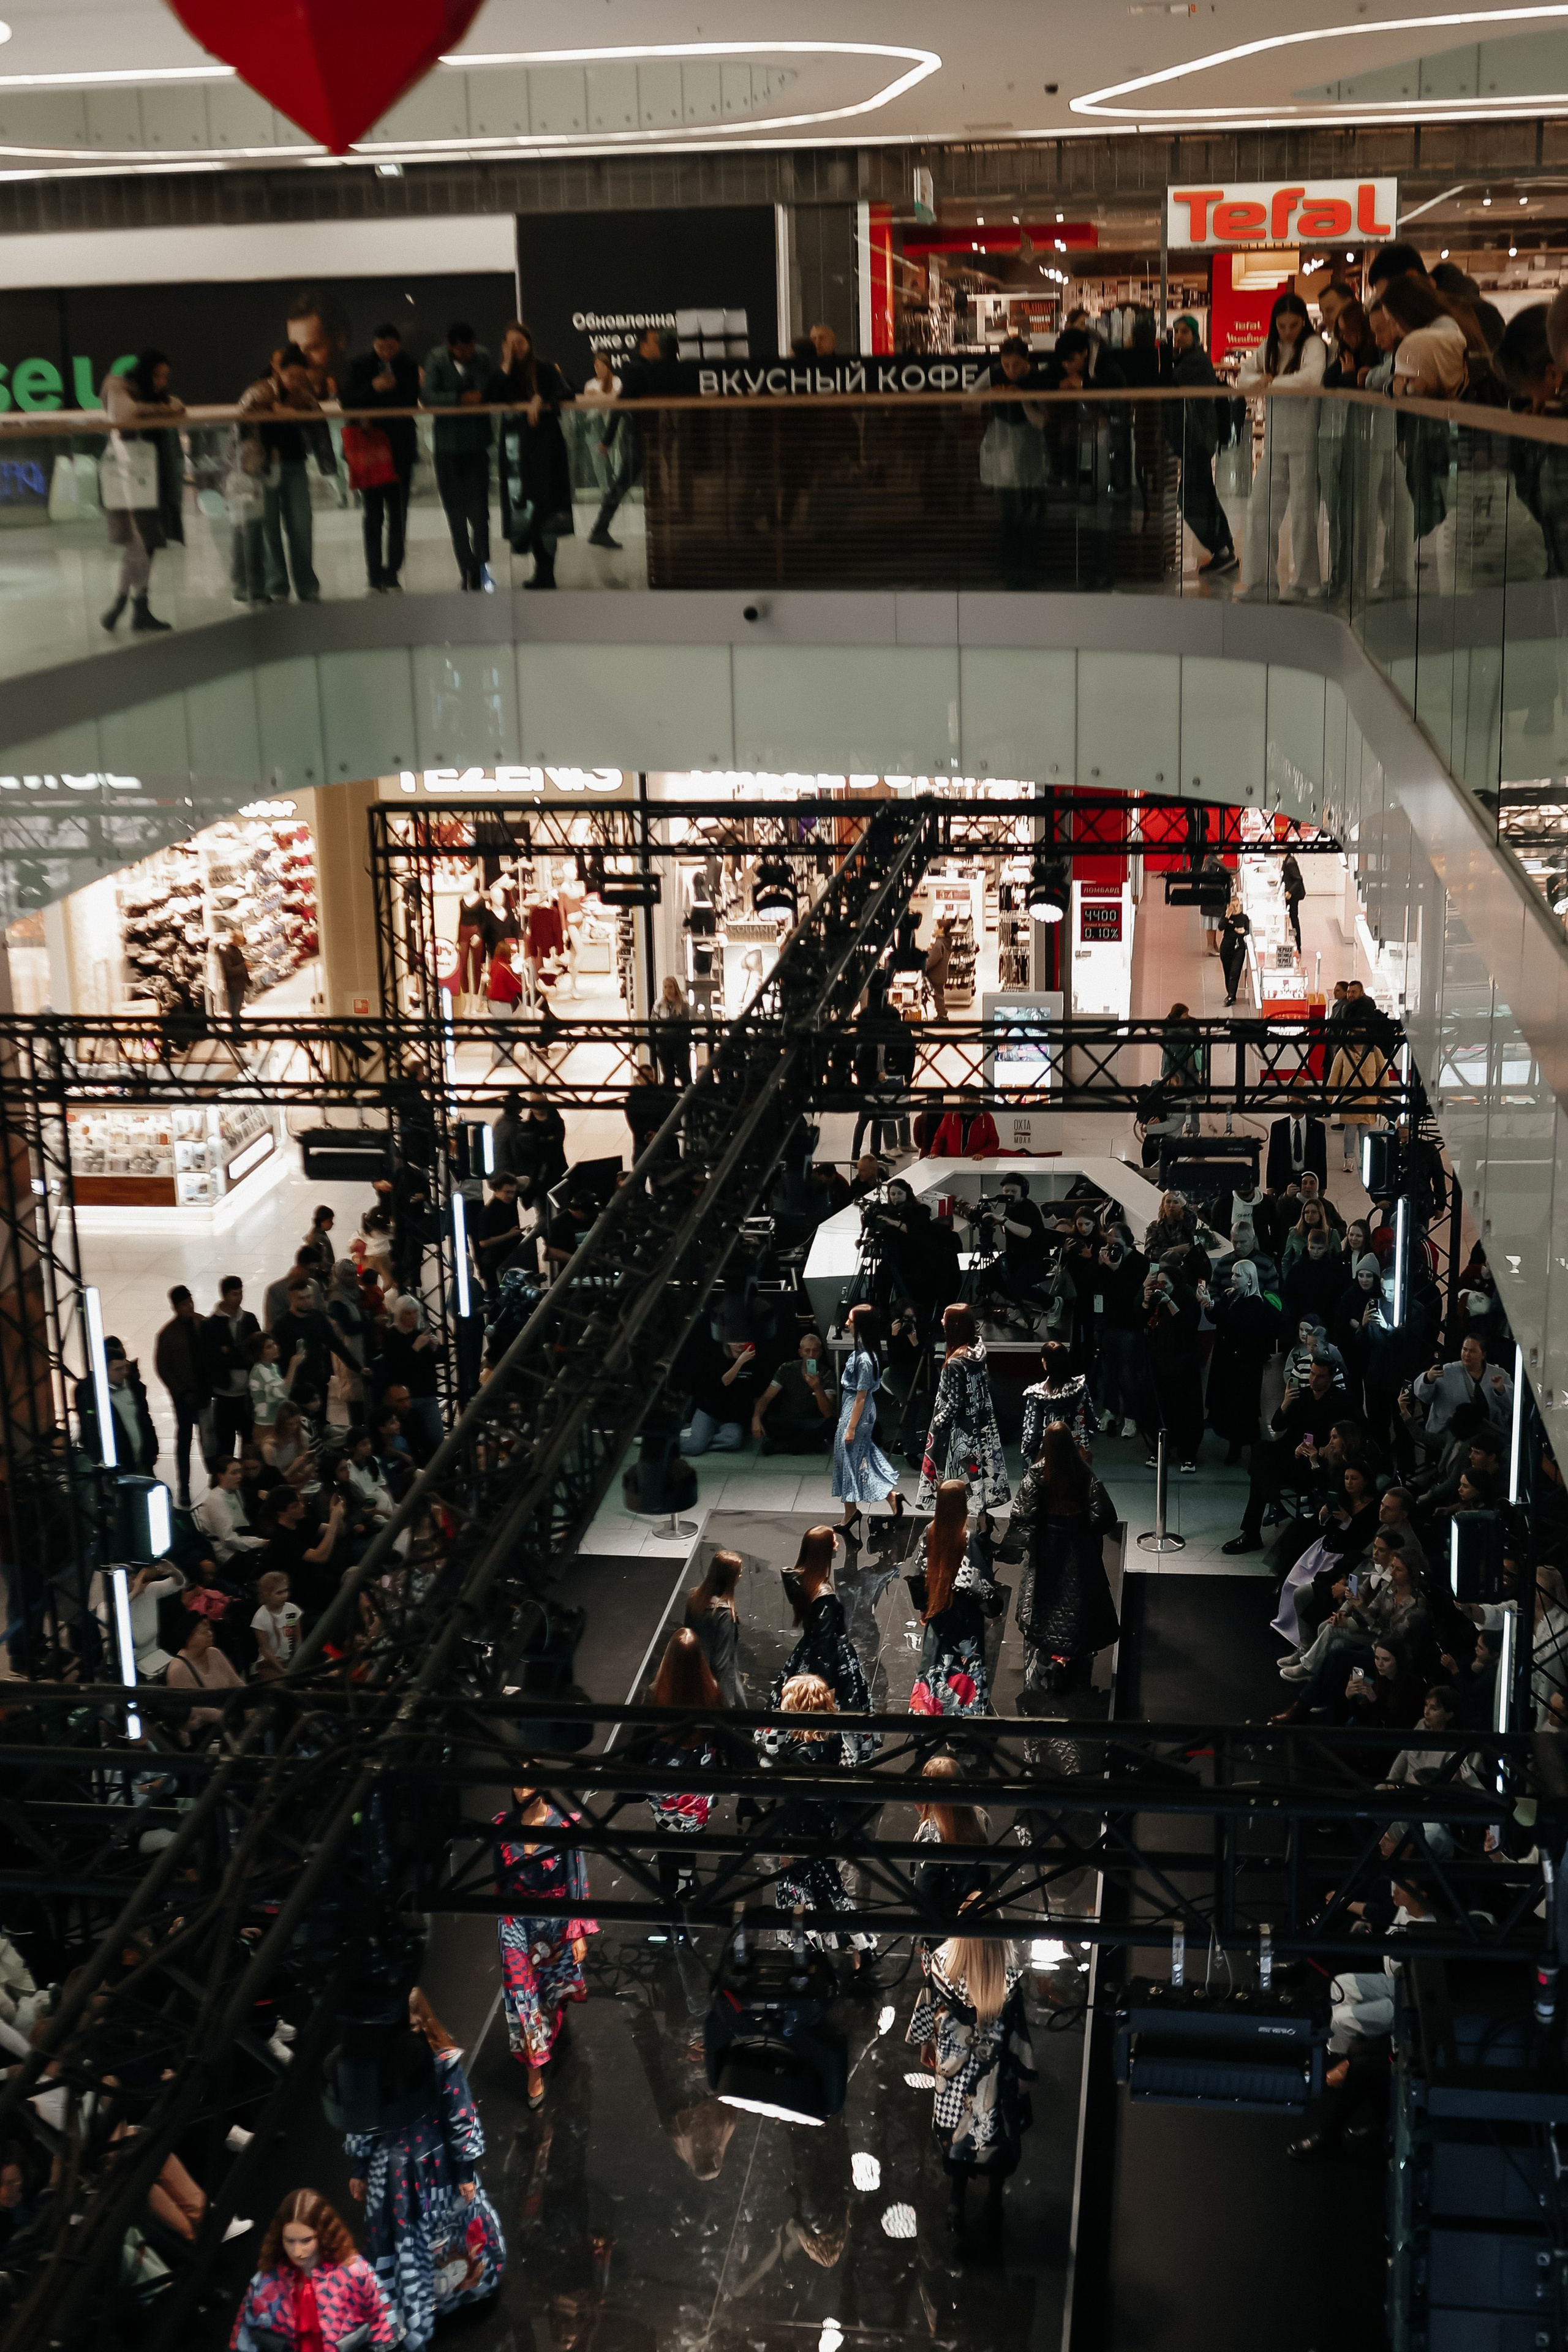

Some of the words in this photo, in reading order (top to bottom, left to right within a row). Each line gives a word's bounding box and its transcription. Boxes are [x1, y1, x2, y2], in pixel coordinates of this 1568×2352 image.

[1173, 184, 1390, 241] Tefal
[699, 360, 865, 396] ВКУСНЫЙ
[878, 364, 978, 394] КОФЕ
[1084, 886, 1120, 895] ЛОМБАРД
[1085, 910, 1117, 922] 4400
[1014, 1119, 1031, 1131] ОХТА
